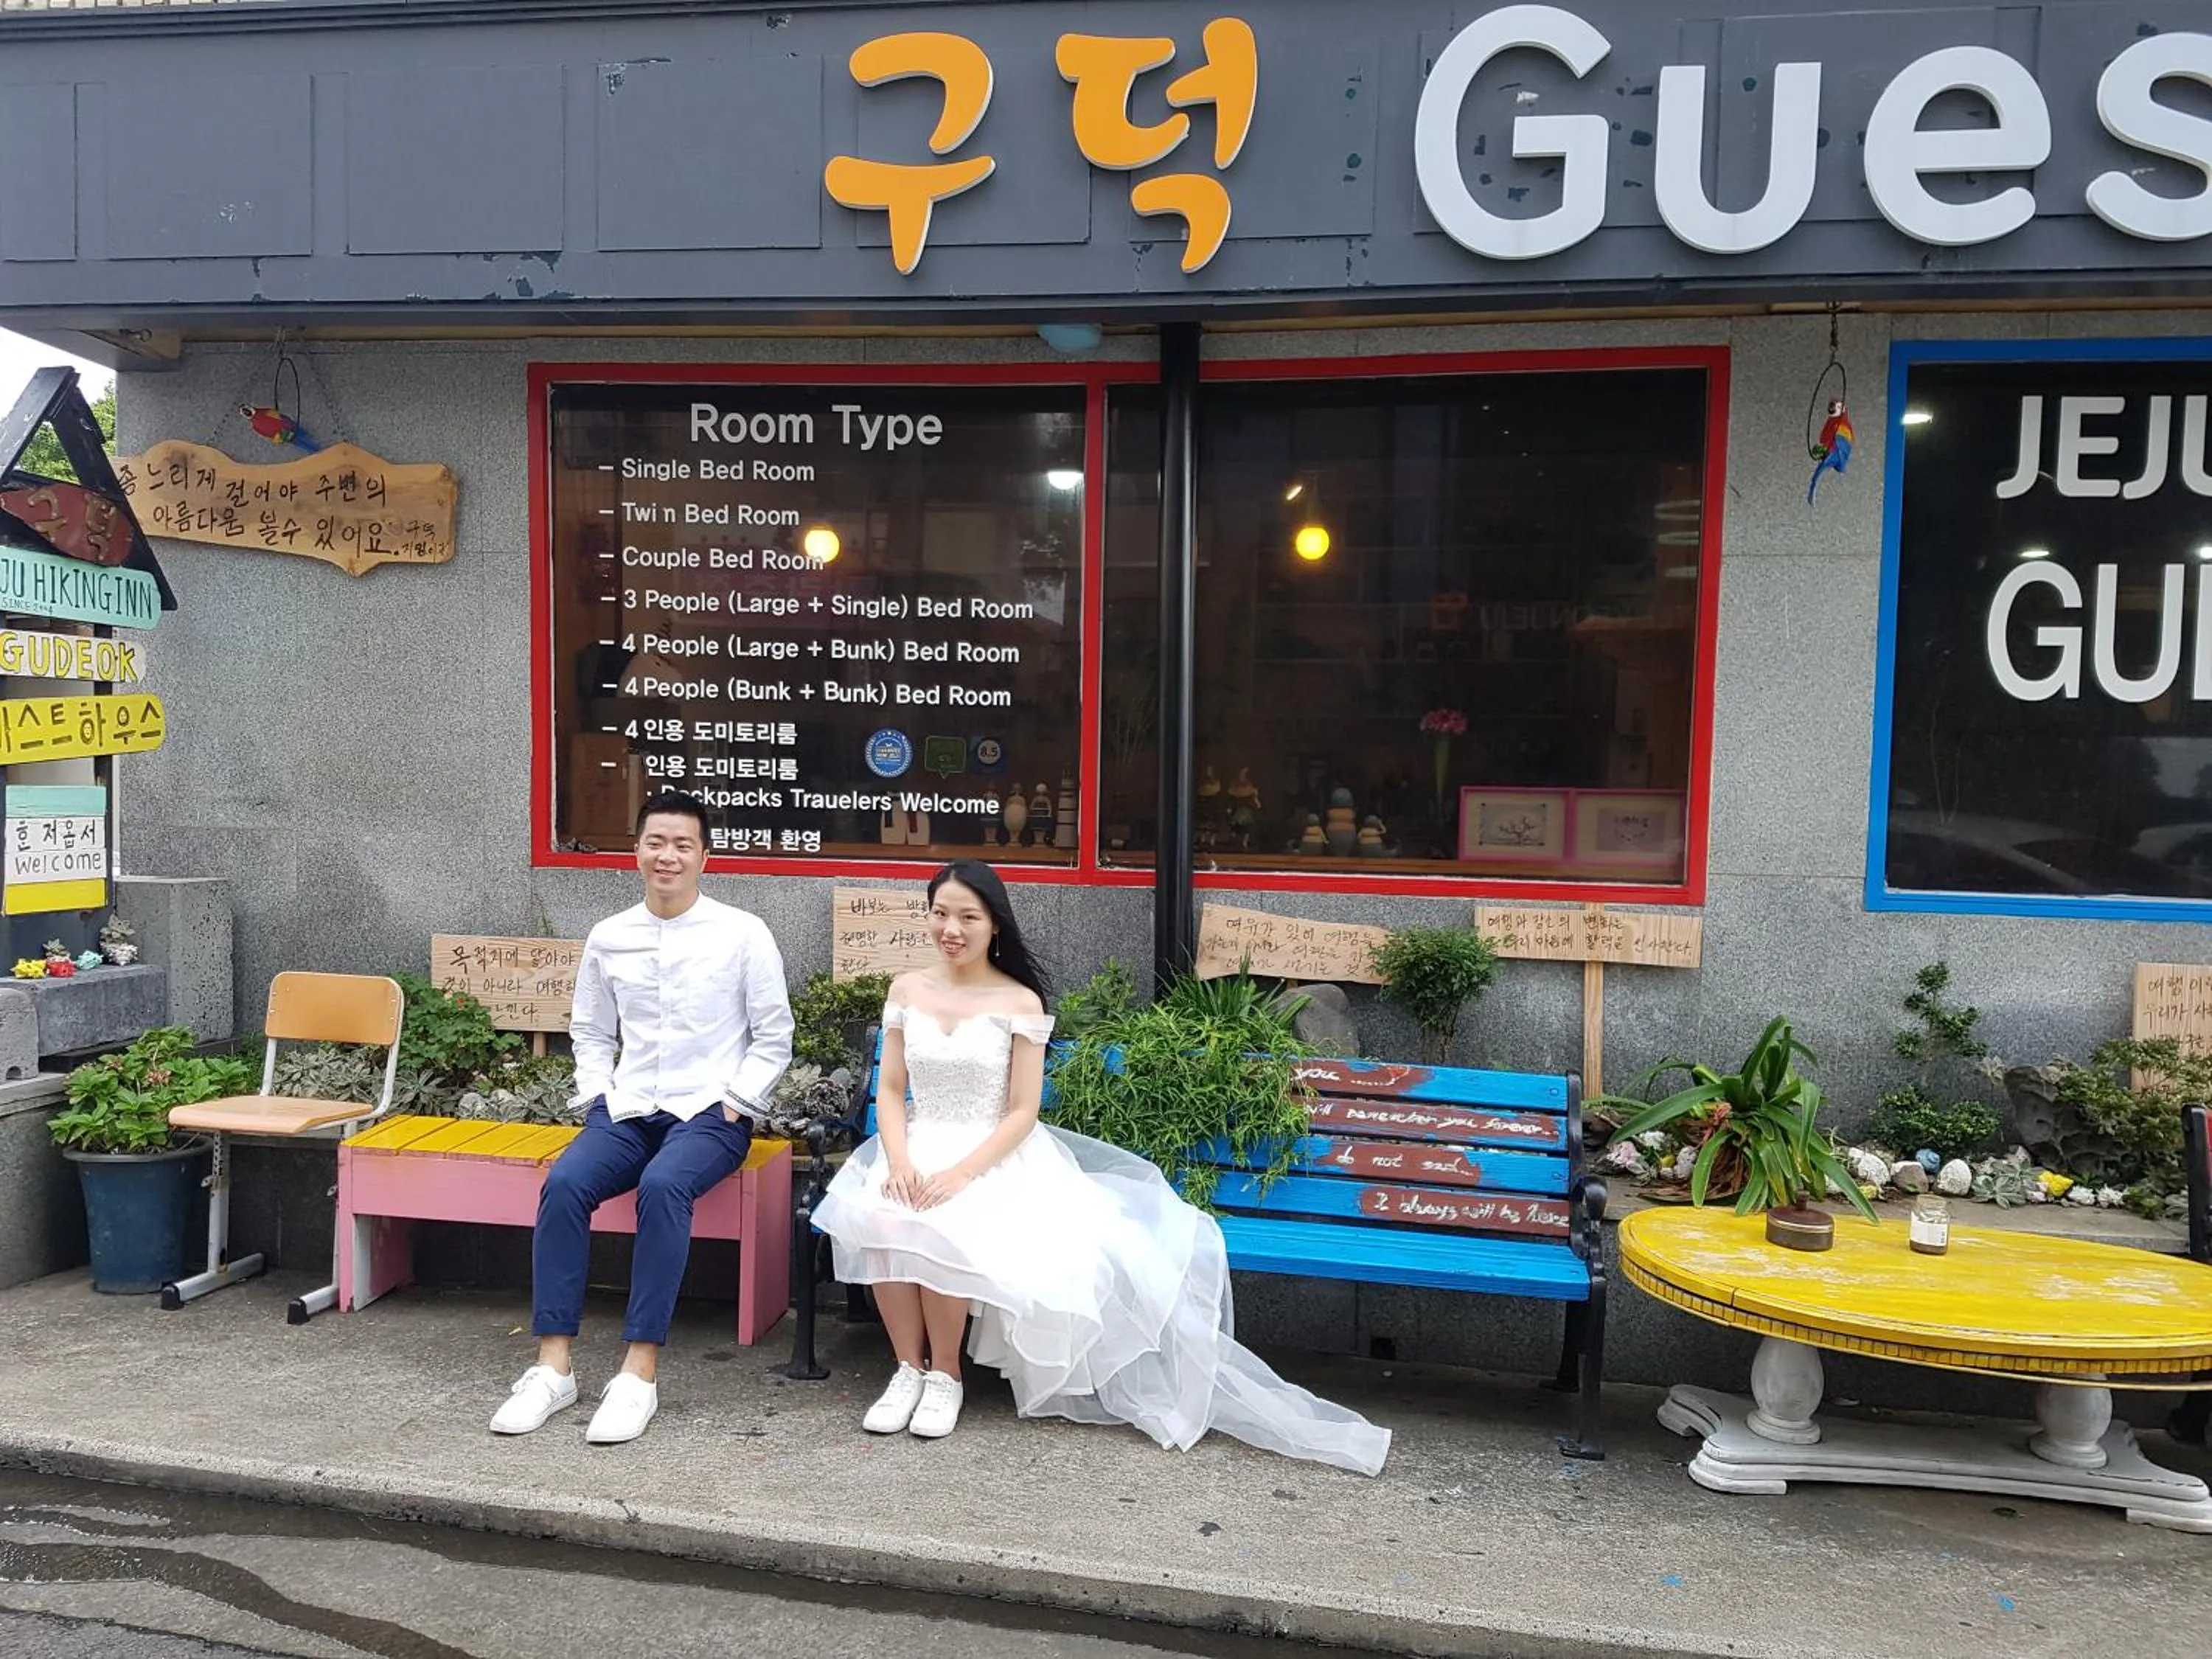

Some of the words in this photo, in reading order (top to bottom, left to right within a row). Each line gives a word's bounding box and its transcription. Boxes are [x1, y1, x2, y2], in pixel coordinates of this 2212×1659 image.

[824, 17, 1259, 275] 구덕
[691, 403, 813, 443] Room
[832, 405, 943, 451] Type
[622, 459, 691, 481] Single
[700, 460, 743, 480] Bed
[753, 460, 815, 481] Room
[147, 462, 216, 493] 느리게
[226, 478, 299, 508] 걸어야
[685, 504, 729, 524] Bed
[738, 505, 800, 526] Room
[622, 546, 700, 571] Couple
[710, 549, 753, 569] Bed
[762, 549, 824, 571] Room
[624, 589, 637, 609] 3
[644, 590, 720, 614] People
[728, 590, 800, 616] (Large
[832, 594, 908, 619] Single)
[917, 597, 962, 617] Bed
[970, 599, 1033, 619] Room
[0, 631, 138, 681] GUDEOK
[622, 633, 636, 653] 4
[643, 634, 720, 657] People
[728, 633, 799, 660] (Large
[831, 638, 895, 663] Bunk)
[904, 641, 948, 661] Bed
[957, 642, 1020, 663] Room
[625, 677, 639, 696] 4
[643, 677, 720, 700] People
[728, 677, 791, 701] (Bunk
[824, 681, 887, 705] Bunk)
[896, 684, 940, 704] Bed
[949, 686, 1011, 706] Room
[692, 720, 798, 745] 도미토리룸
[645, 754, 686, 779] 인용
[694, 757, 799, 781] 도미토리룸
[900, 792, 1001, 815] Welcome
[710, 827, 773, 851] 탐방객
[781, 829, 822, 852] 환영
